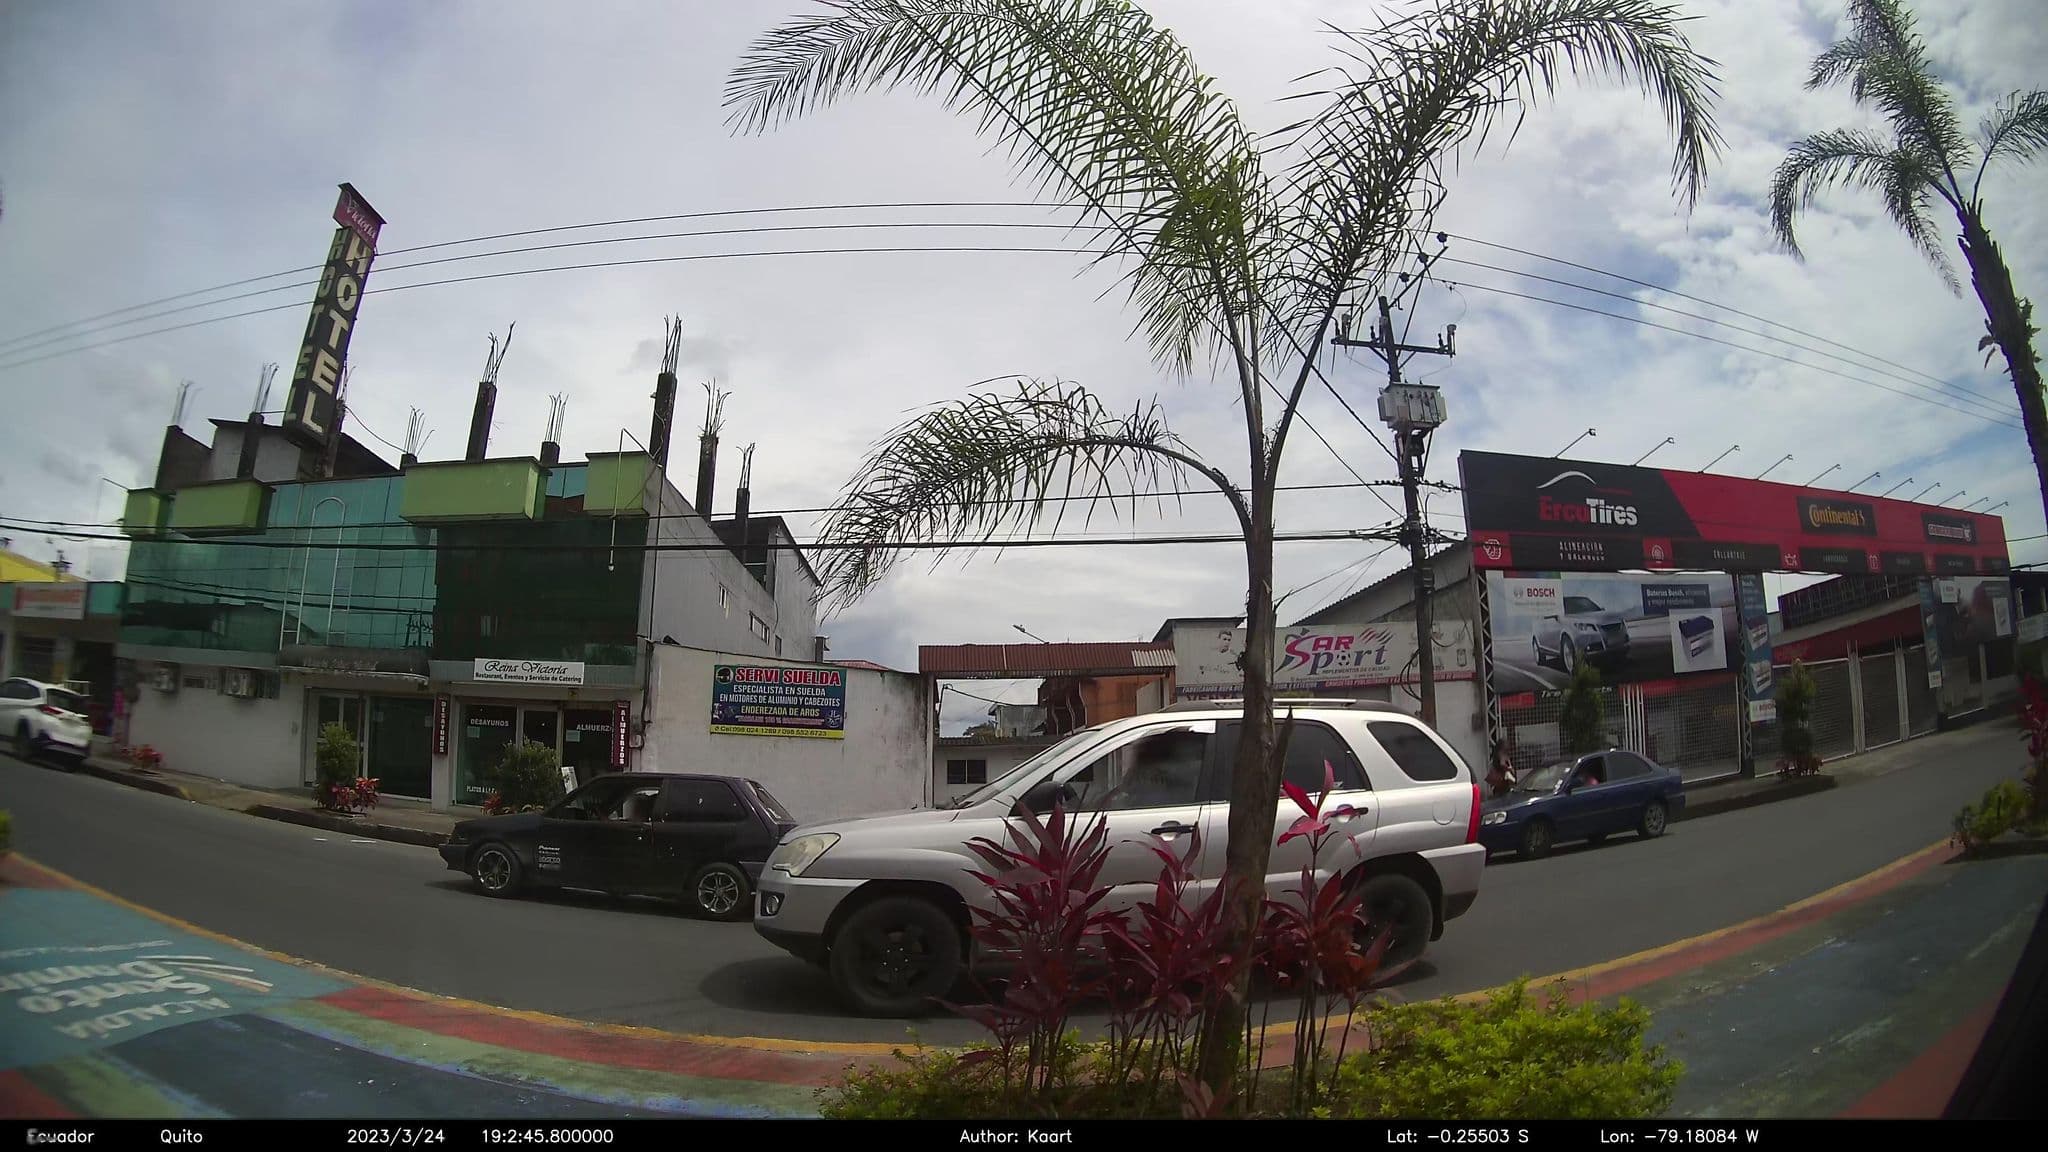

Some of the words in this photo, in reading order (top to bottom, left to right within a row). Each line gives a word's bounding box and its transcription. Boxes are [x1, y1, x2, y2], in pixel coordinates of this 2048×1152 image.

[302, 236, 371, 433] HOTEL
[1538, 495, 1638, 526] ErcuTires
[1808, 503, 1860, 527] Continental
[1526, 588, 1555, 597] BOSCH
[485, 660, 519, 673] Reina
[521, 661, 569, 675] Victoria
[735, 667, 780, 684] SERVI
[782, 668, 841, 687] SUELDA
[733, 684, 784, 695] ESPECIALISTA
[785, 687, 795, 695] EN
[796, 687, 826, 696] SUELDA
[720, 693, 729, 702] EN
[729, 694, 758, 703] MOTORES
[758, 695, 767, 704] DE
[767, 696, 798, 705] ALUMINIO
[804, 697, 841, 707] CABEZOTES
[741, 705, 788, 716] ENDEREZADA
[788, 707, 799, 716] DE
[799, 708, 820, 717] AROS
[439, 701, 447, 753] DESAYUNOS
[470, 718, 510, 727] DESAYUNOS
